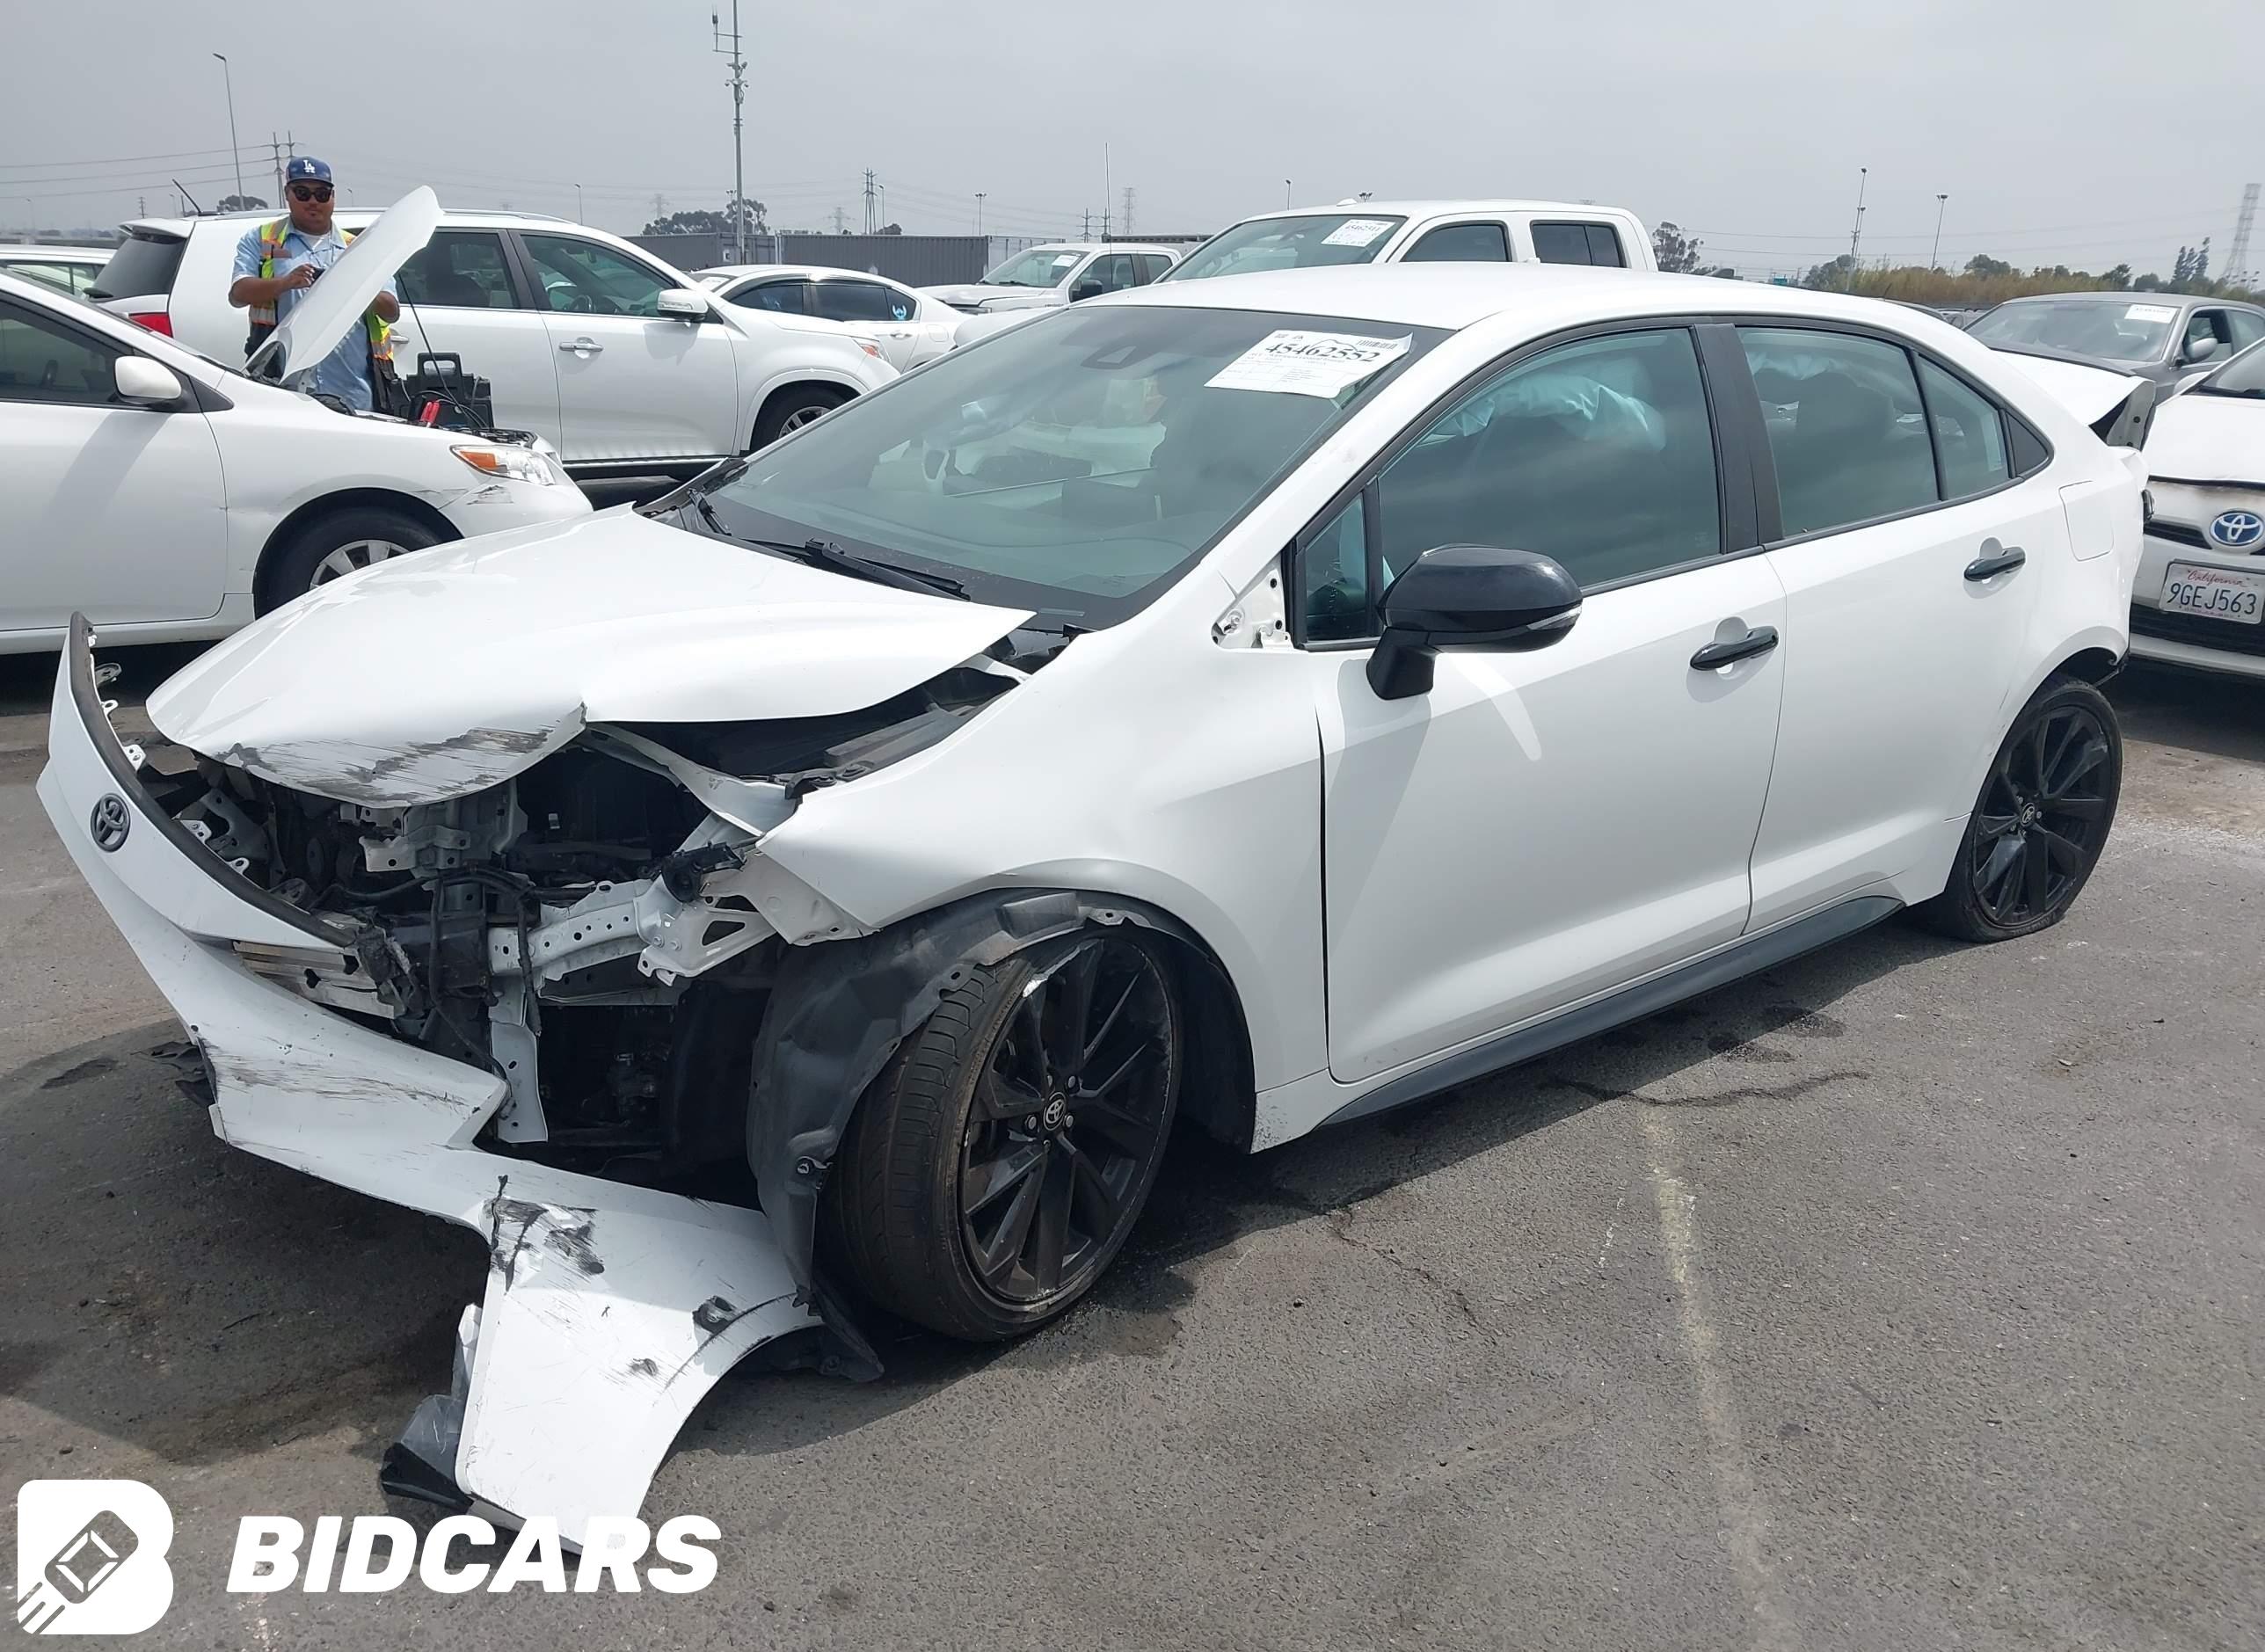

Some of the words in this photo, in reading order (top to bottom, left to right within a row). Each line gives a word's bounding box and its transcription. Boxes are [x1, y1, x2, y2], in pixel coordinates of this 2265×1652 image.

[302, 159, 316, 173] LA
[1265, 343, 1380, 362] 45462552
[2188, 570, 2248, 587] California
[2167, 582, 2257, 615] 9GEJ563
